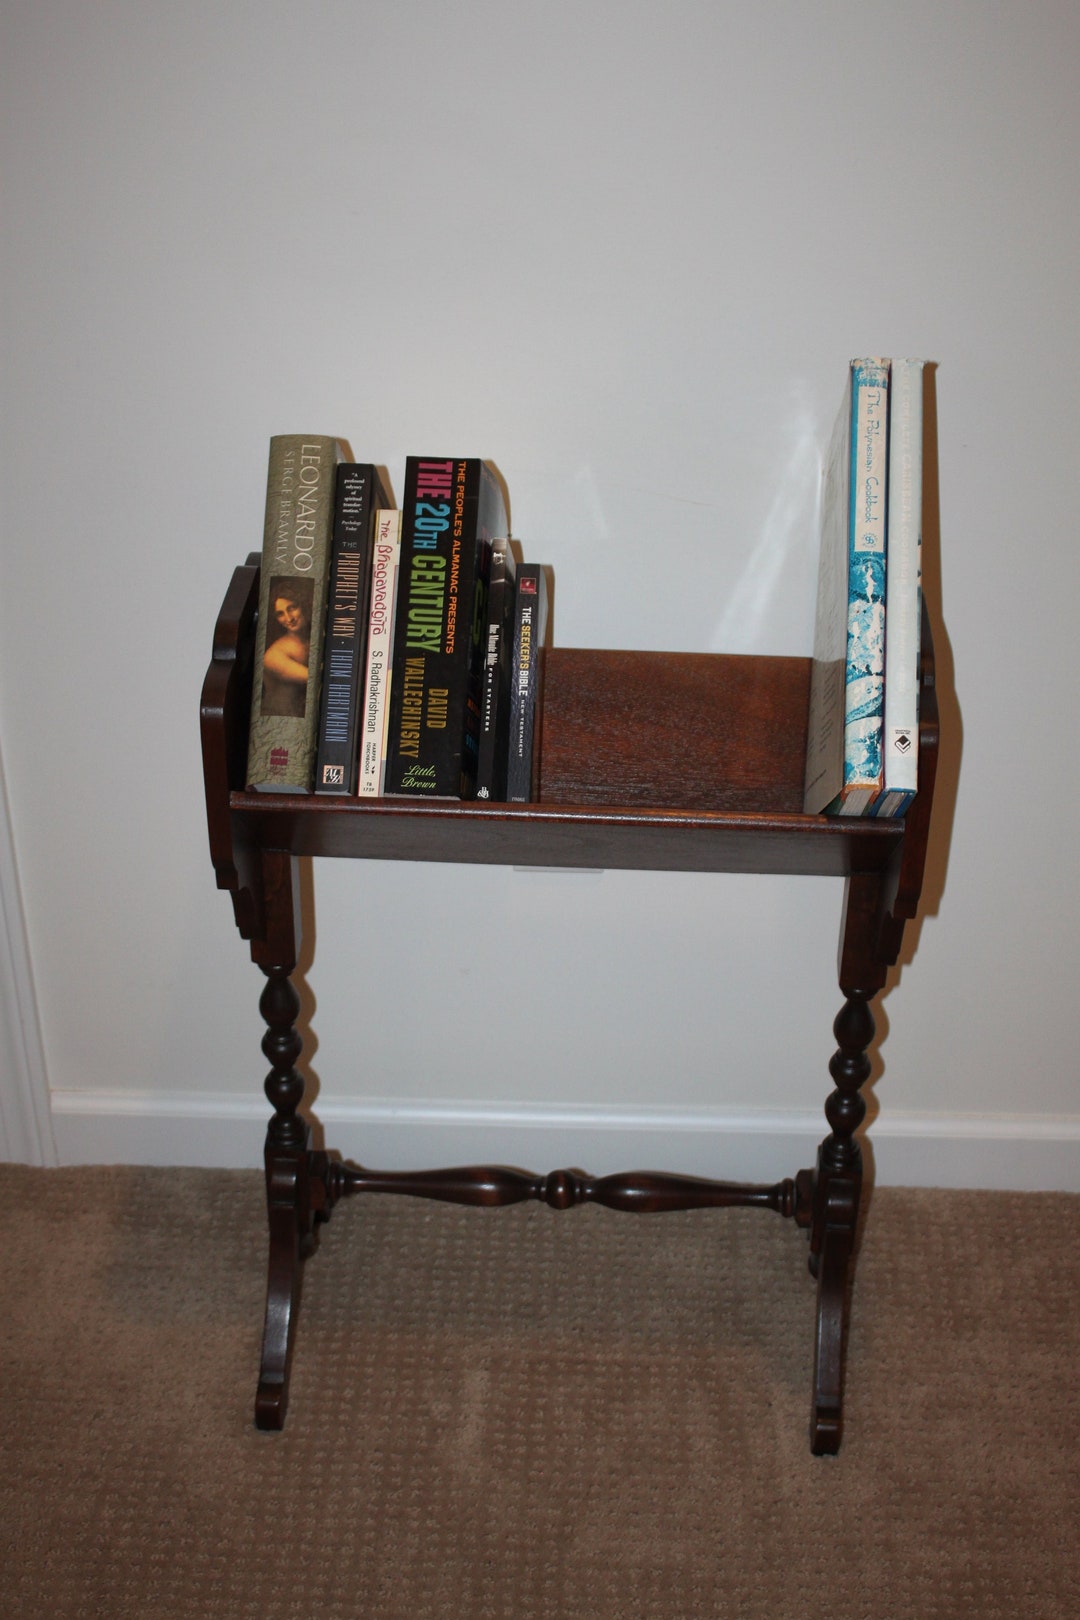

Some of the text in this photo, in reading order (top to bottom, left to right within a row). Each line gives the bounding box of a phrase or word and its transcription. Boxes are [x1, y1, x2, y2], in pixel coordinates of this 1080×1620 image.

[867, 391, 880, 414] The
[865, 420, 879, 472] Polynesian
[276, 451, 295, 564] SERGE BRAMLY
[292, 444, 321, 572] LEONARDO
[865, 476, 879, 523] Cookbook
[380, 520, 391, 541] The
[406, 461, 453, 653] THE 20TH CENTURY
[446, 461, 467, 654] THE PEOPLE'S ALMANAC PRESENTS
[334, 552, 360, 611] PROPHET'S
[332, 617, 356, 638] WAY
[522, 607, 532, 624] THE
[329, 649, 353, 677] THOM
[487, 653, 498, 665] Bible
[520, 625, 531, 669] SEEKER'S
[367, 650, 383, 733] S. Radhakrishnan
[519, 670, 529, 696] BIBLE
[325, 684, 351, 742] HARTMANN
[400, 657, 425, 758] VALLECHINSKY
[426, 688, 448, 729] DAVID
[401, 776, 436, 788] Brown
[404, 765, 436, 777] Little,
